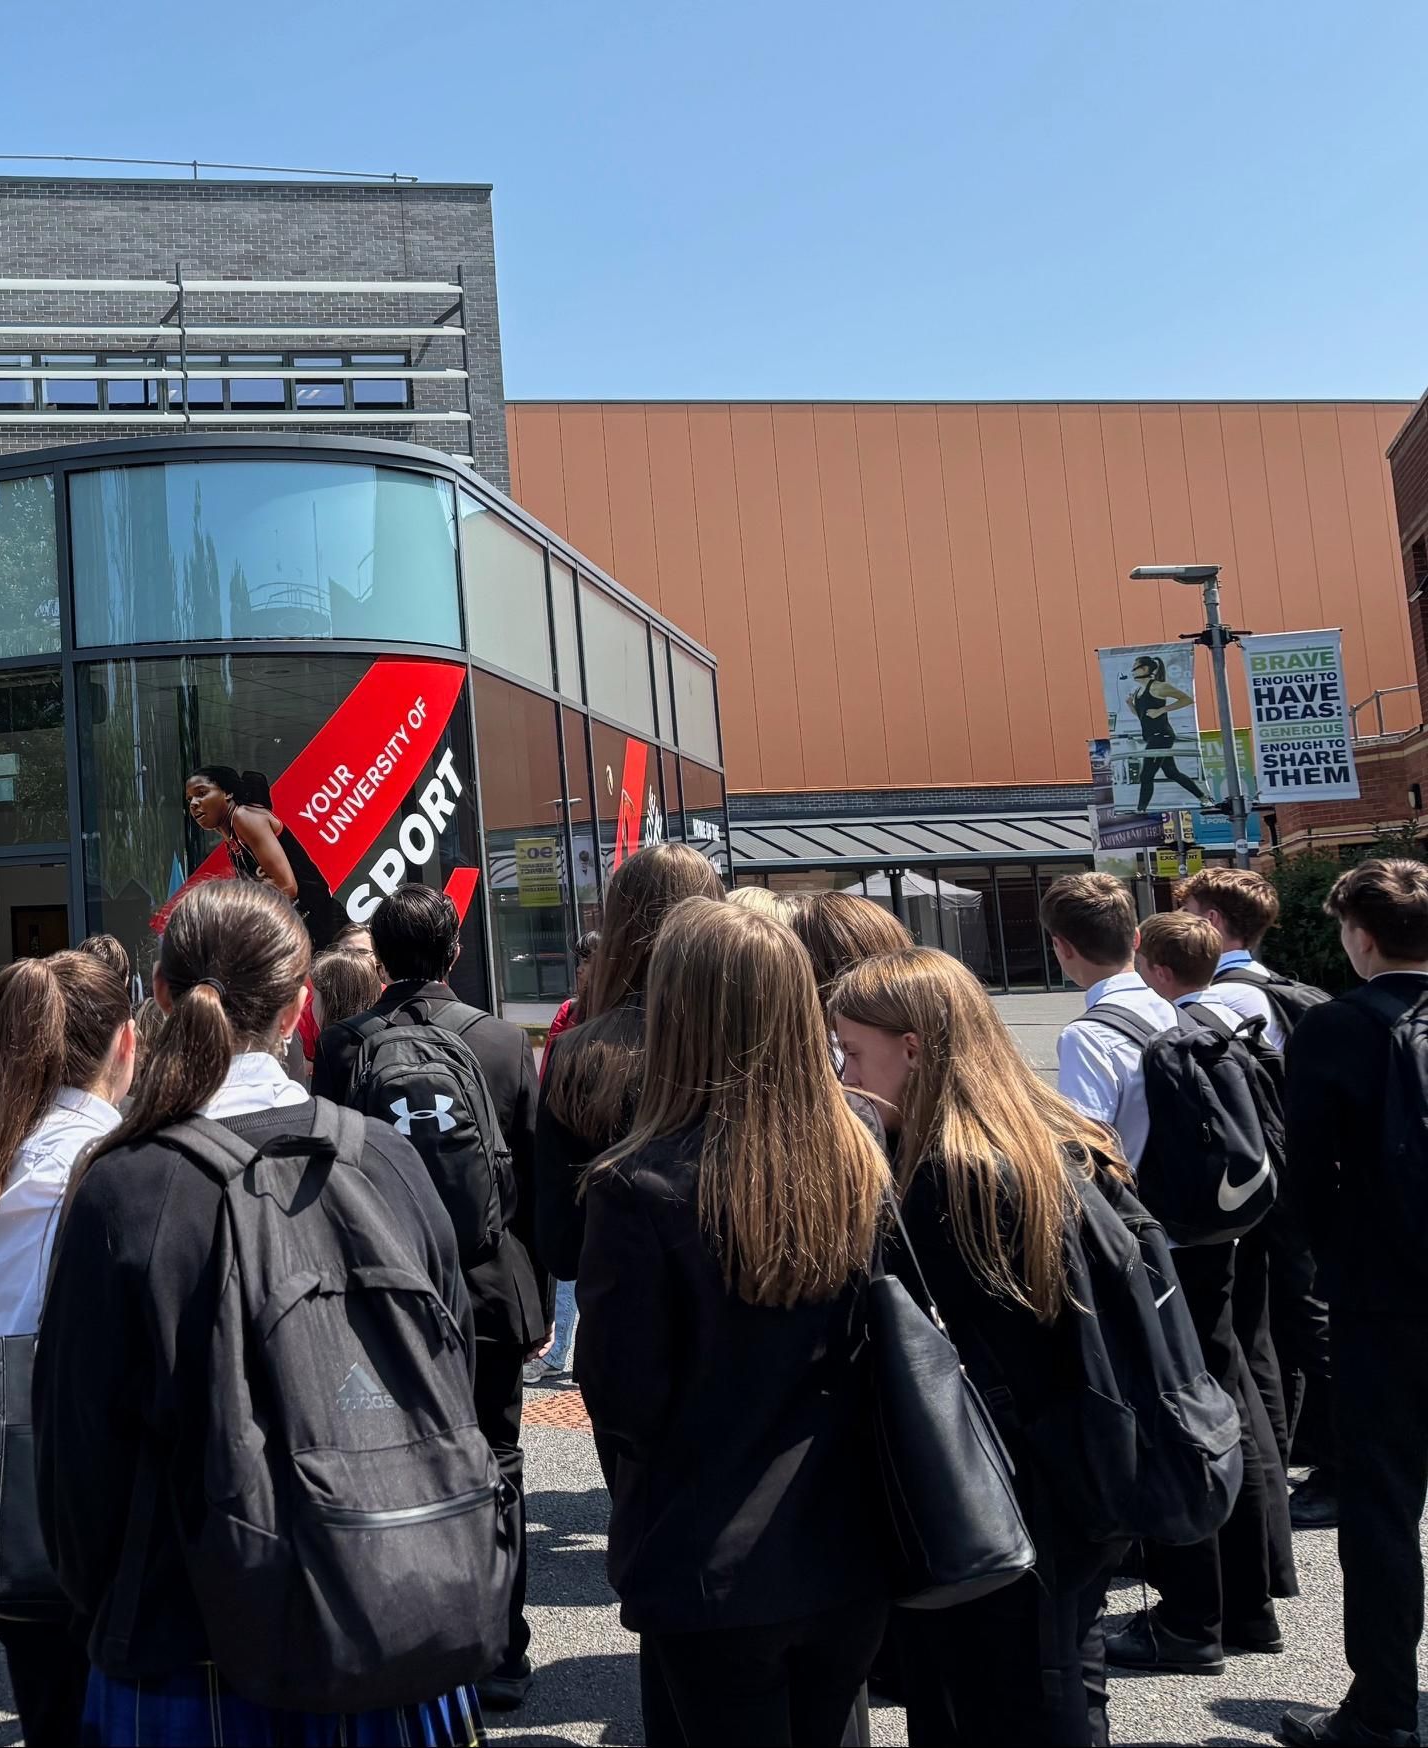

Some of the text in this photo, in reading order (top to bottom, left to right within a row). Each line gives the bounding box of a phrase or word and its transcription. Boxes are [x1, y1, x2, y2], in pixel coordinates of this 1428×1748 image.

[1250, 651, 1336, 672] BRAVE
[1252, 671, 1338, 687] ENOUGH TO
[1254, 682, 1341, 706] HAVE
[1256, 702, 1343, 723] IDEAS:
[1259, 723, 1345, 738] GENEROUS
[1260, 738, 1346, 753] ENOUGH TO
[318, 695, 427, 844] UNIVERSITY OF
[1263, 749, 1348, 769] SHARE
[1263, 766, 1351, 788] THEM
[298, 764, 355, 824] YOUR
[345, 747, 462, 923] SPORT
